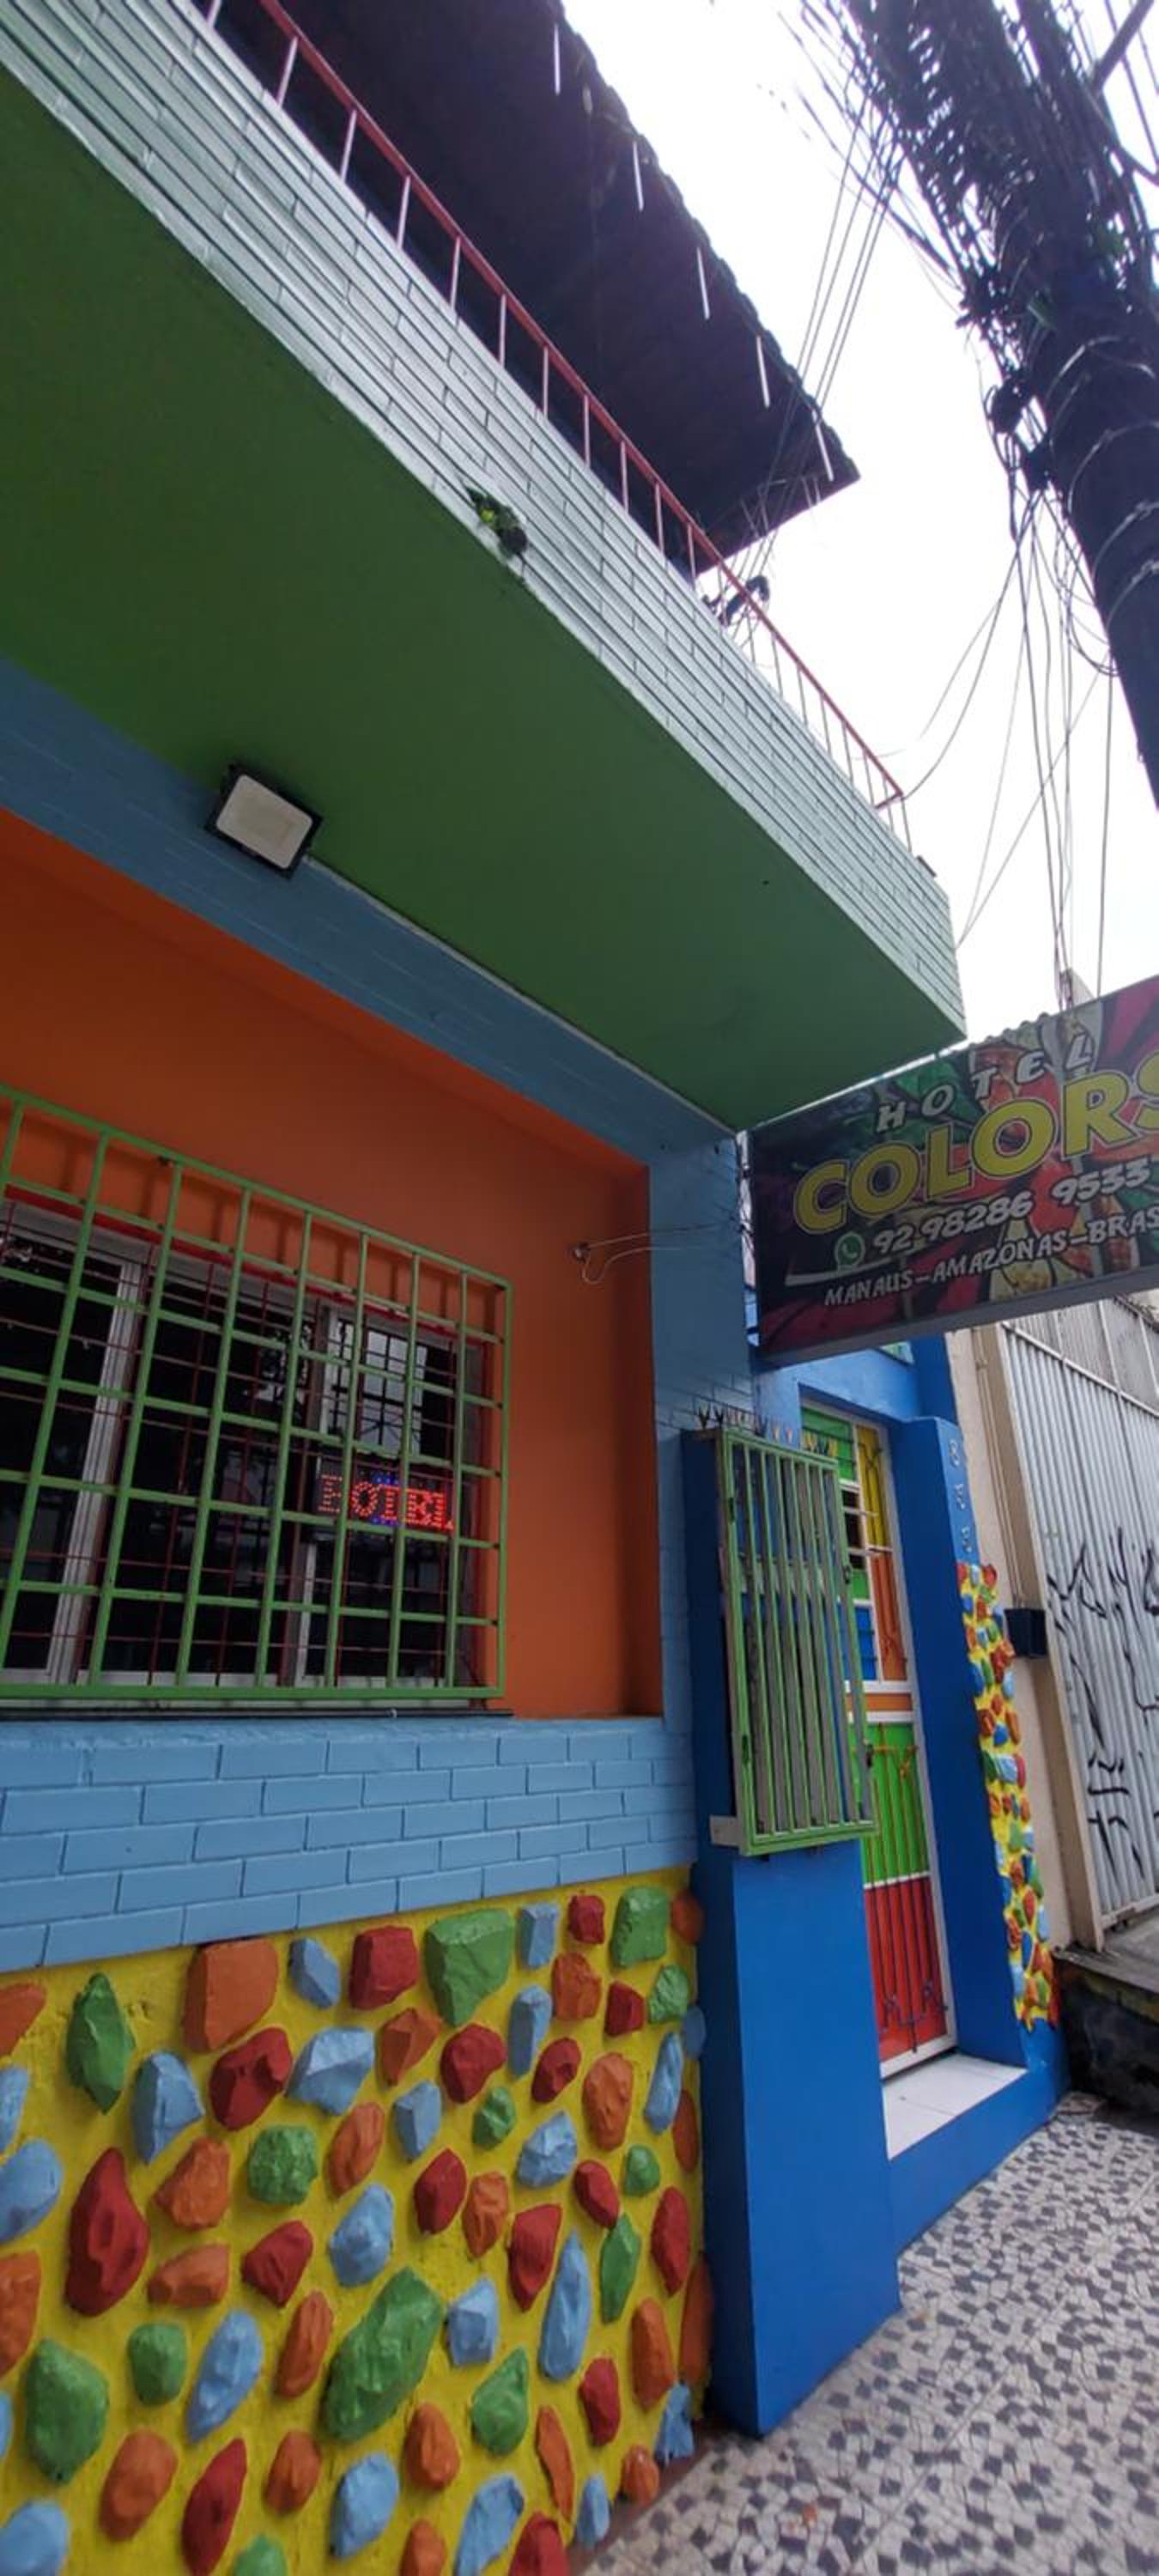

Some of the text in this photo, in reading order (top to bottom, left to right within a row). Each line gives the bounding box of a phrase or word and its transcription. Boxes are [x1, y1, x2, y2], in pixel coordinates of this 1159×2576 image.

[877, 1033, 1092, 1133] HOTEL
[872, 1157, 1150, 1254] 92 98286 9533
